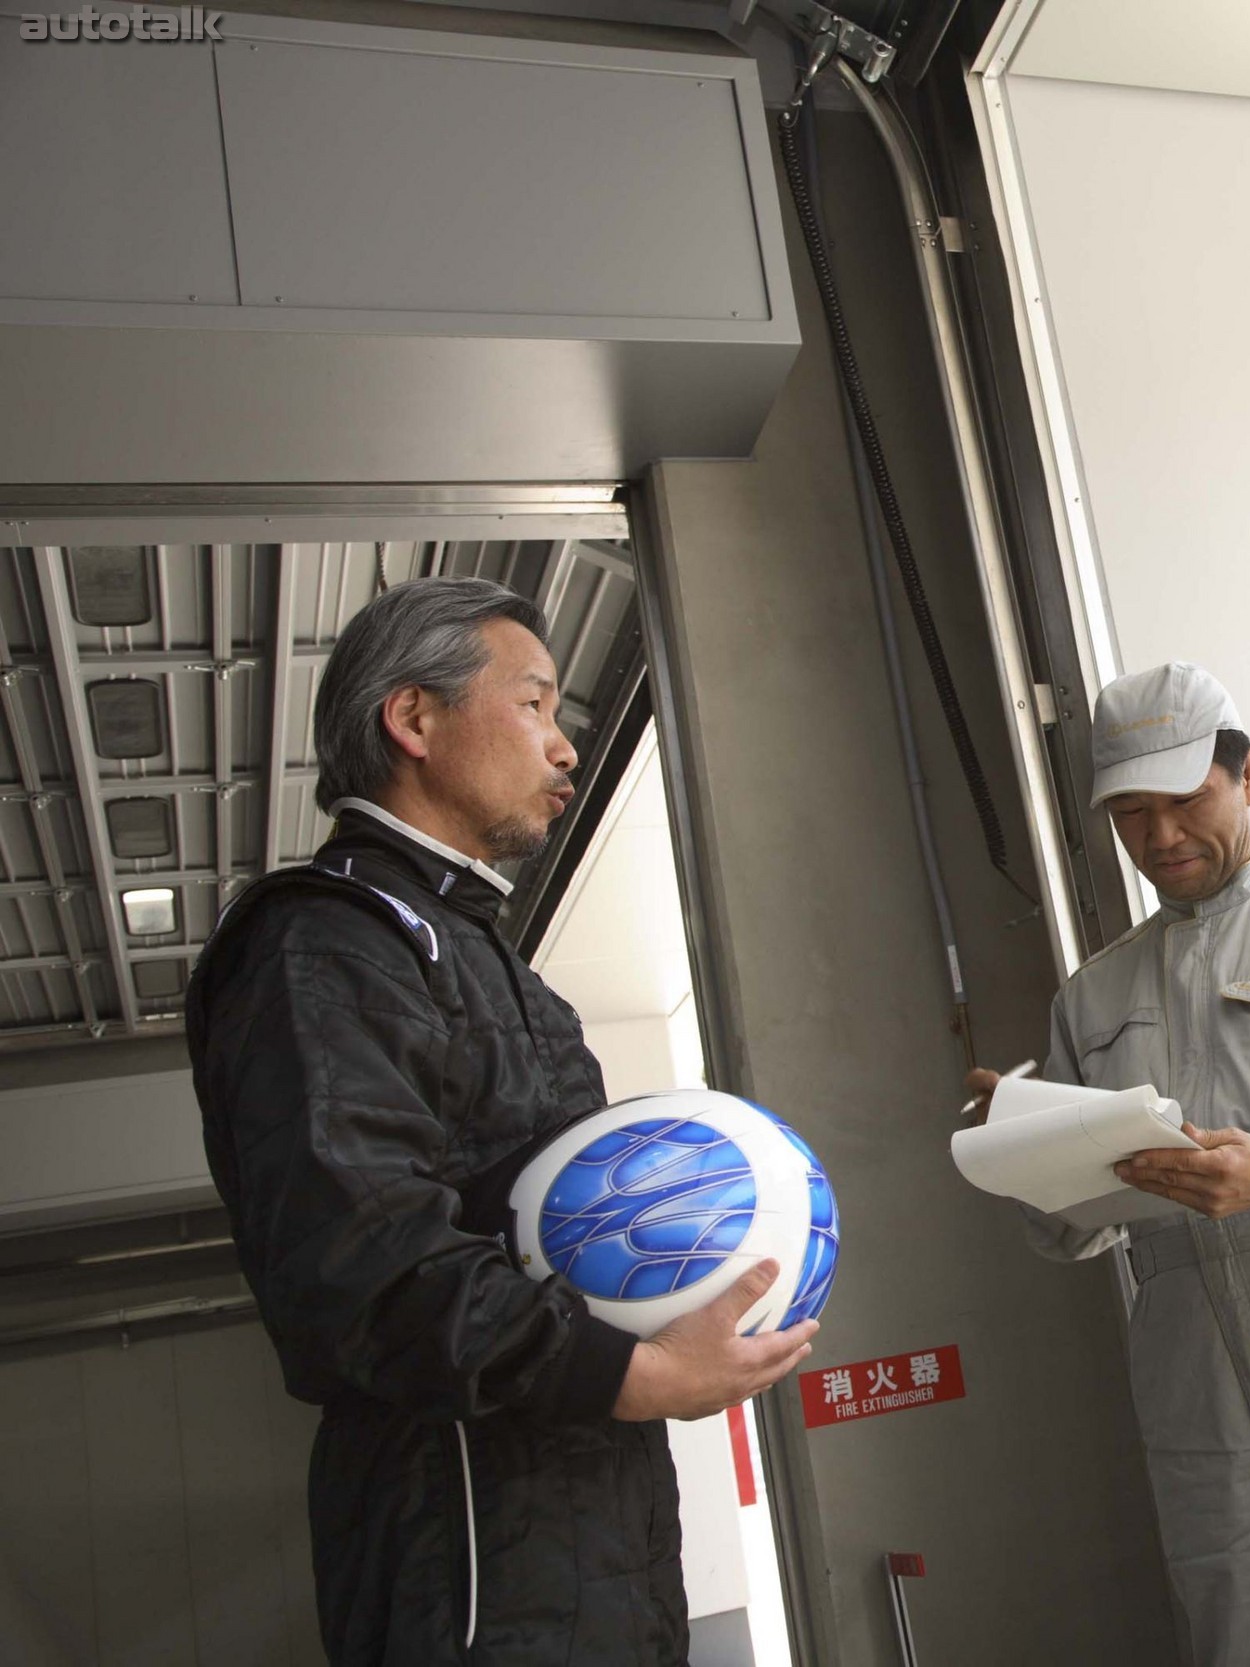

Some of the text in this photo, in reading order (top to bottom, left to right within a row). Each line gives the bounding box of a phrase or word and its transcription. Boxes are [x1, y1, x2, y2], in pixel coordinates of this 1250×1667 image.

[822, 1353, 941, 1404] 消火器
[835, 1387, 934, 1418] FIRE EXTINGUISHER
